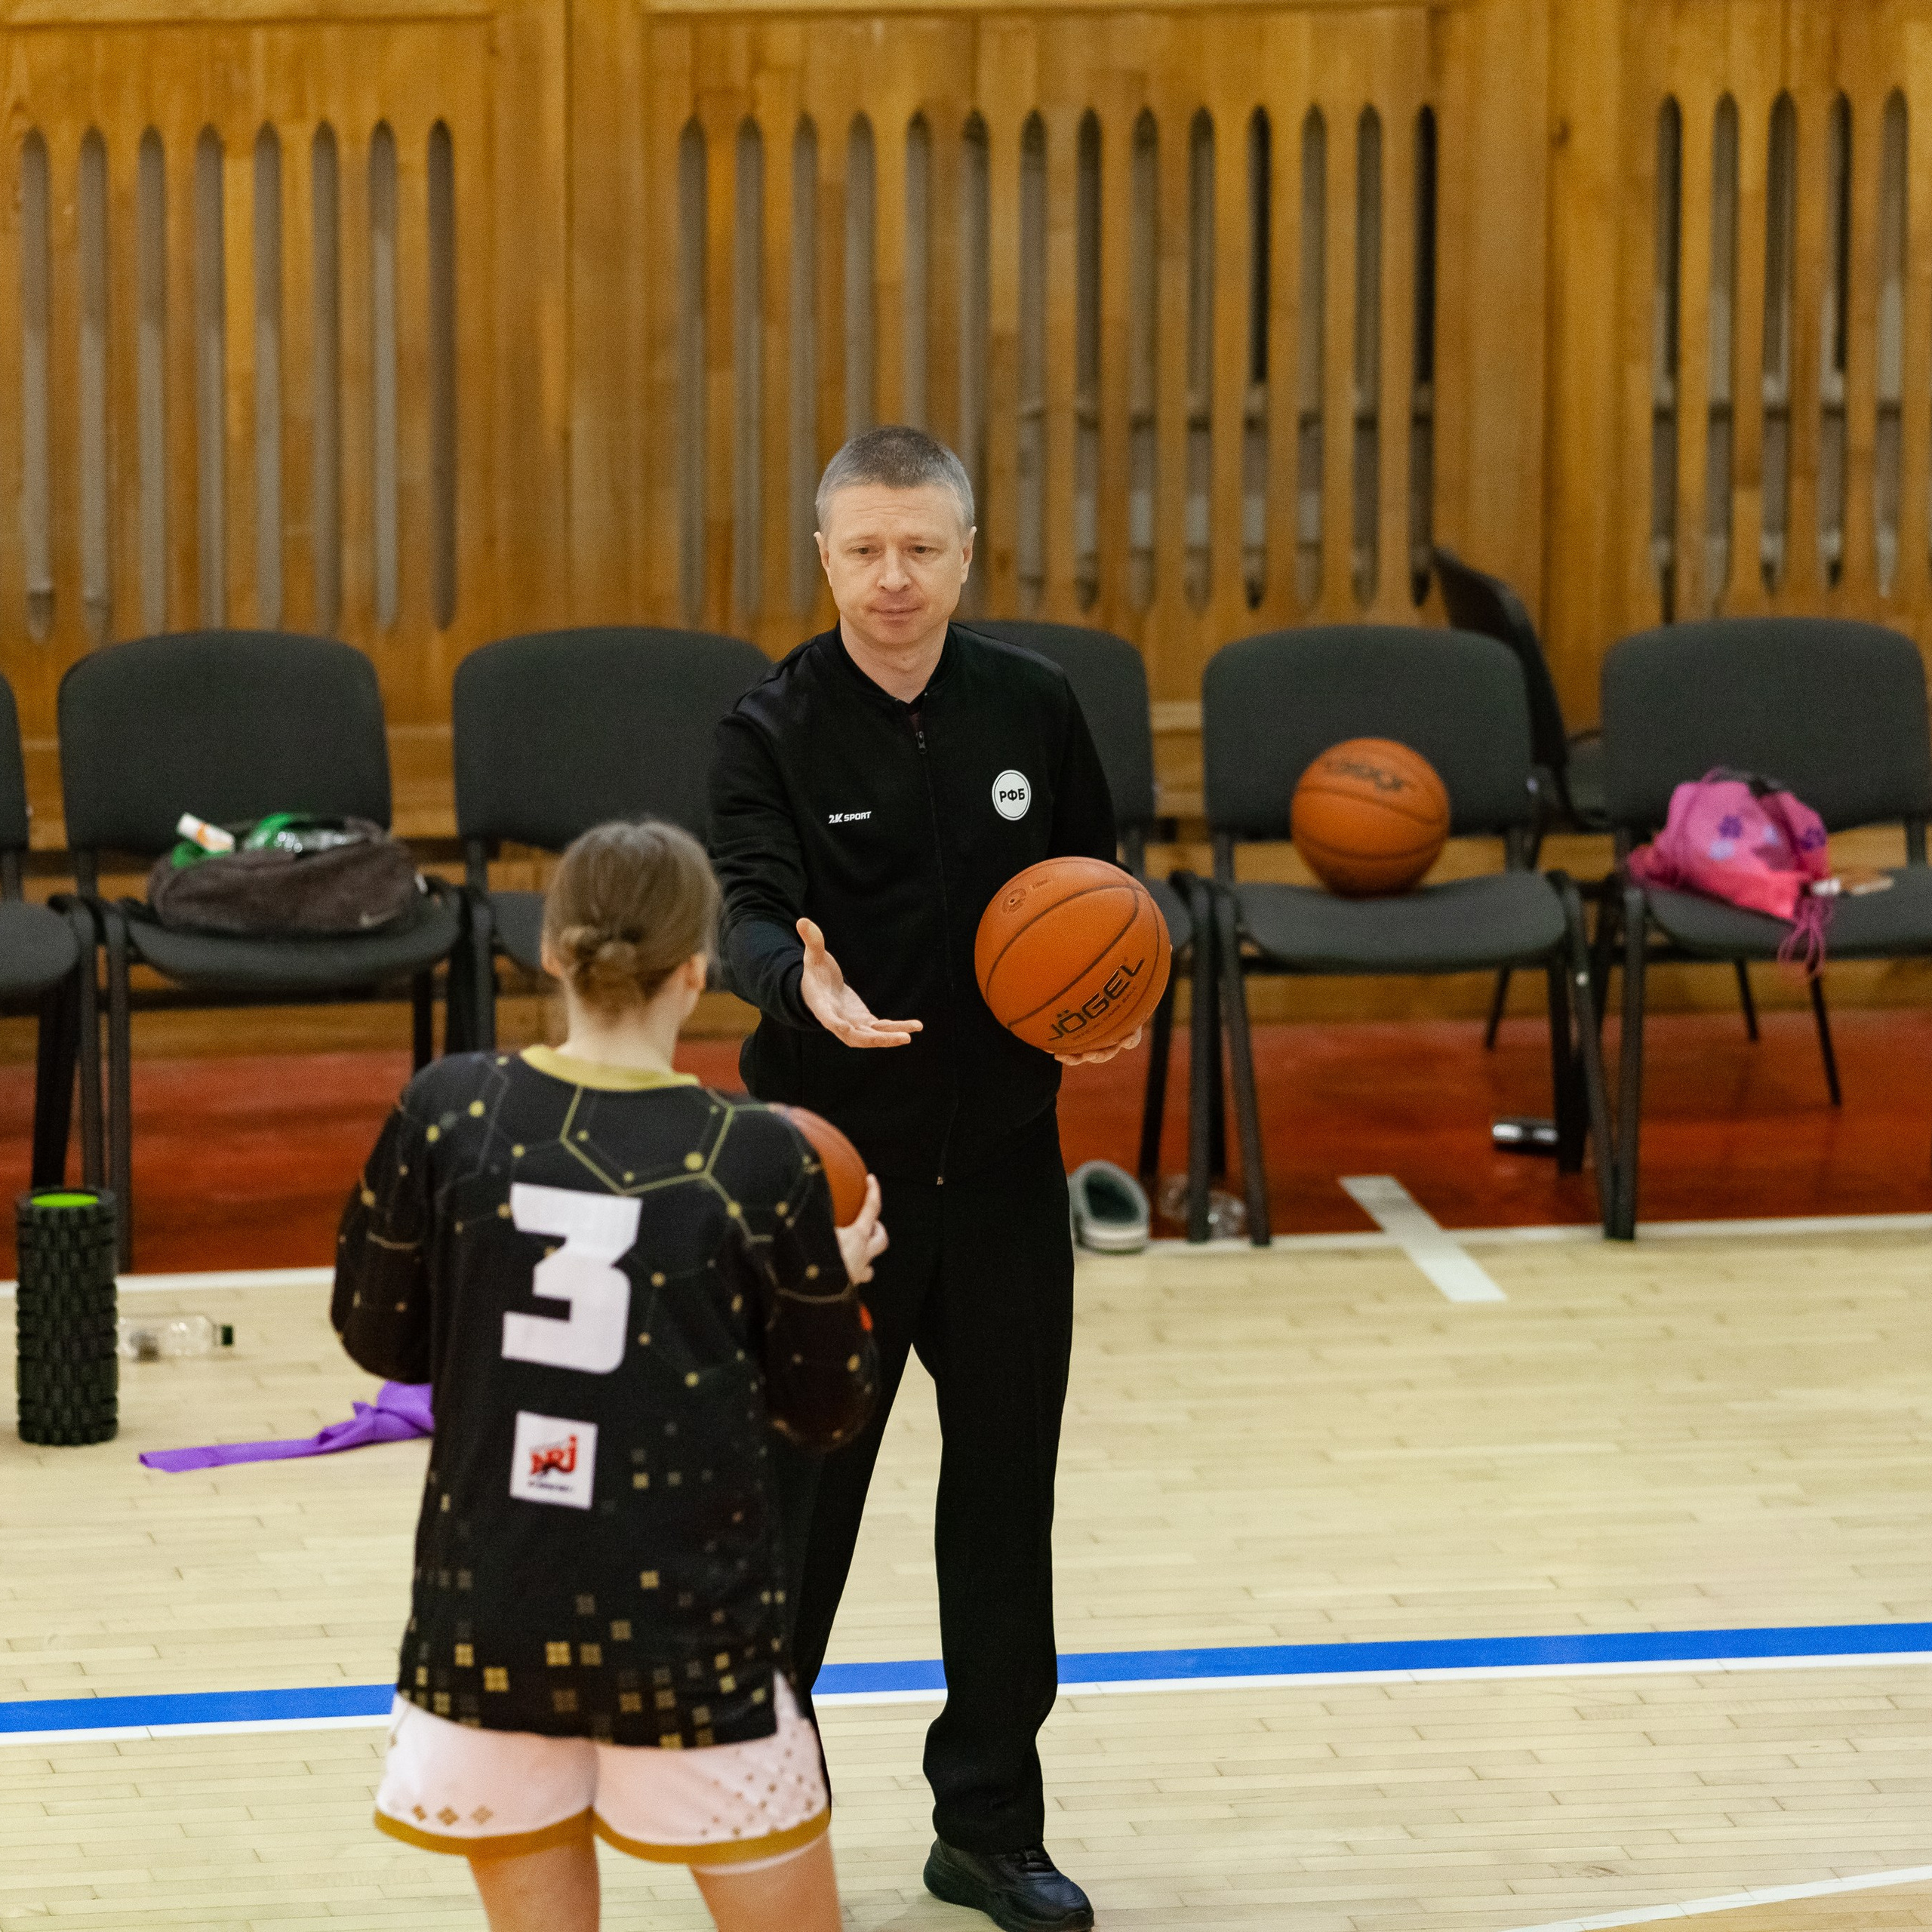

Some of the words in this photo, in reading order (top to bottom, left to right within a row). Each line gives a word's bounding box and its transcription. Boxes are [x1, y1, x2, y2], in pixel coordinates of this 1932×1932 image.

[828, 813, 844, 824] 2K
[844, 811, 872, 822] SPORT
[999, 788, 1025, 803] РФБ
[1048, 958, 1145, 1041] JÖGEL
[501, 1182, 642, 1375] 3
